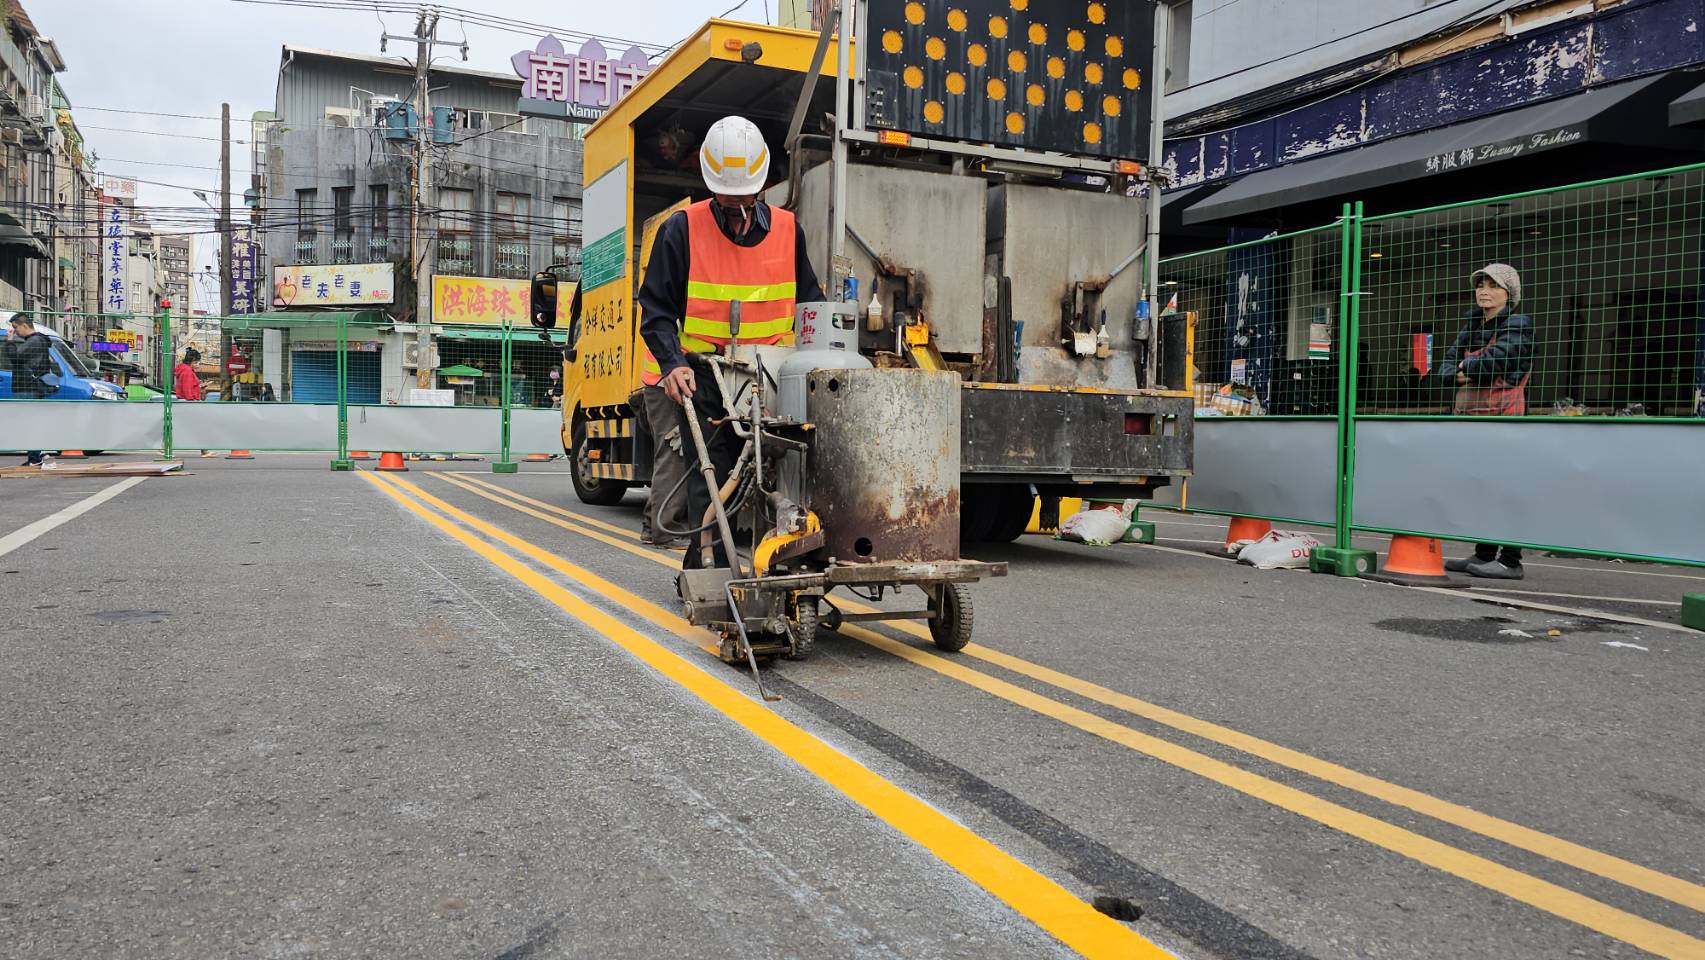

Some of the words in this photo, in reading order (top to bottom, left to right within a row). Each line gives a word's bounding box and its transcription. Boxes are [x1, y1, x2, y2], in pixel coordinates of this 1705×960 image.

[1477, 145, 1524, 160] Luxury
[1528, 130, 1581, 149] Fashion
[302, 274, 361, 298] 老夫老妻
